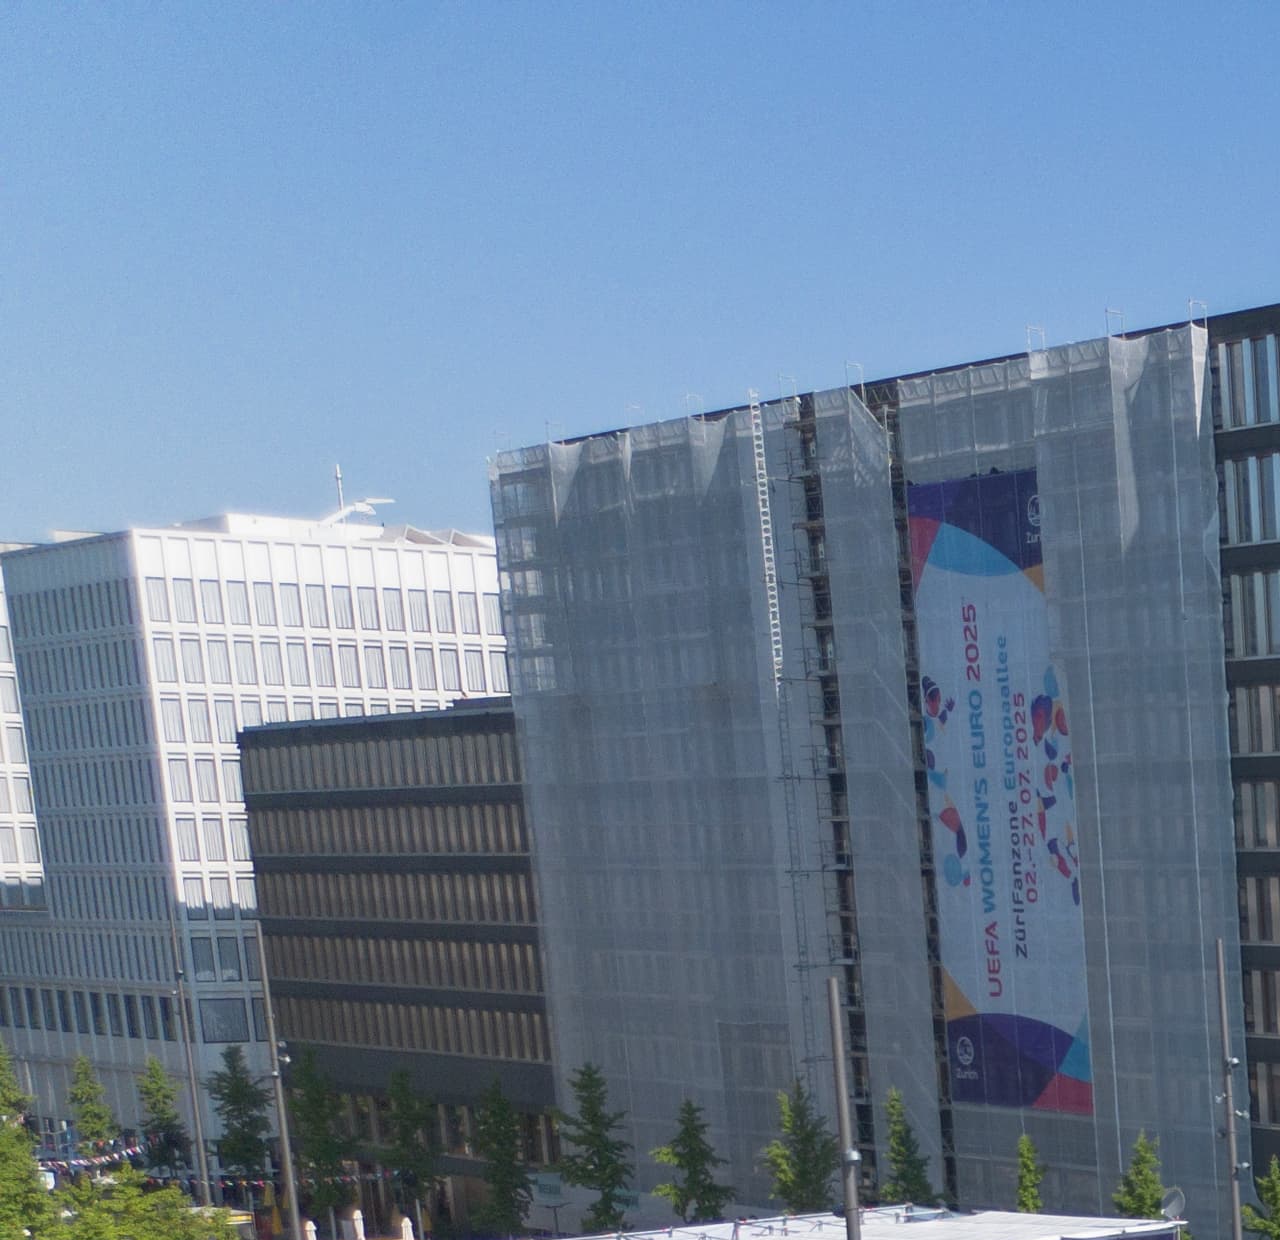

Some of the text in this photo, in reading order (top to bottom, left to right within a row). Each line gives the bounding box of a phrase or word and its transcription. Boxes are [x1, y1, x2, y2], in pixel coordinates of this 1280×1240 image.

[996, 635, 1017, 790] Europaallee
[1013, 692, 1029, 761] 2025
[962, 603, 1003, 998] UEFA WOMEN'S EURO 2025
